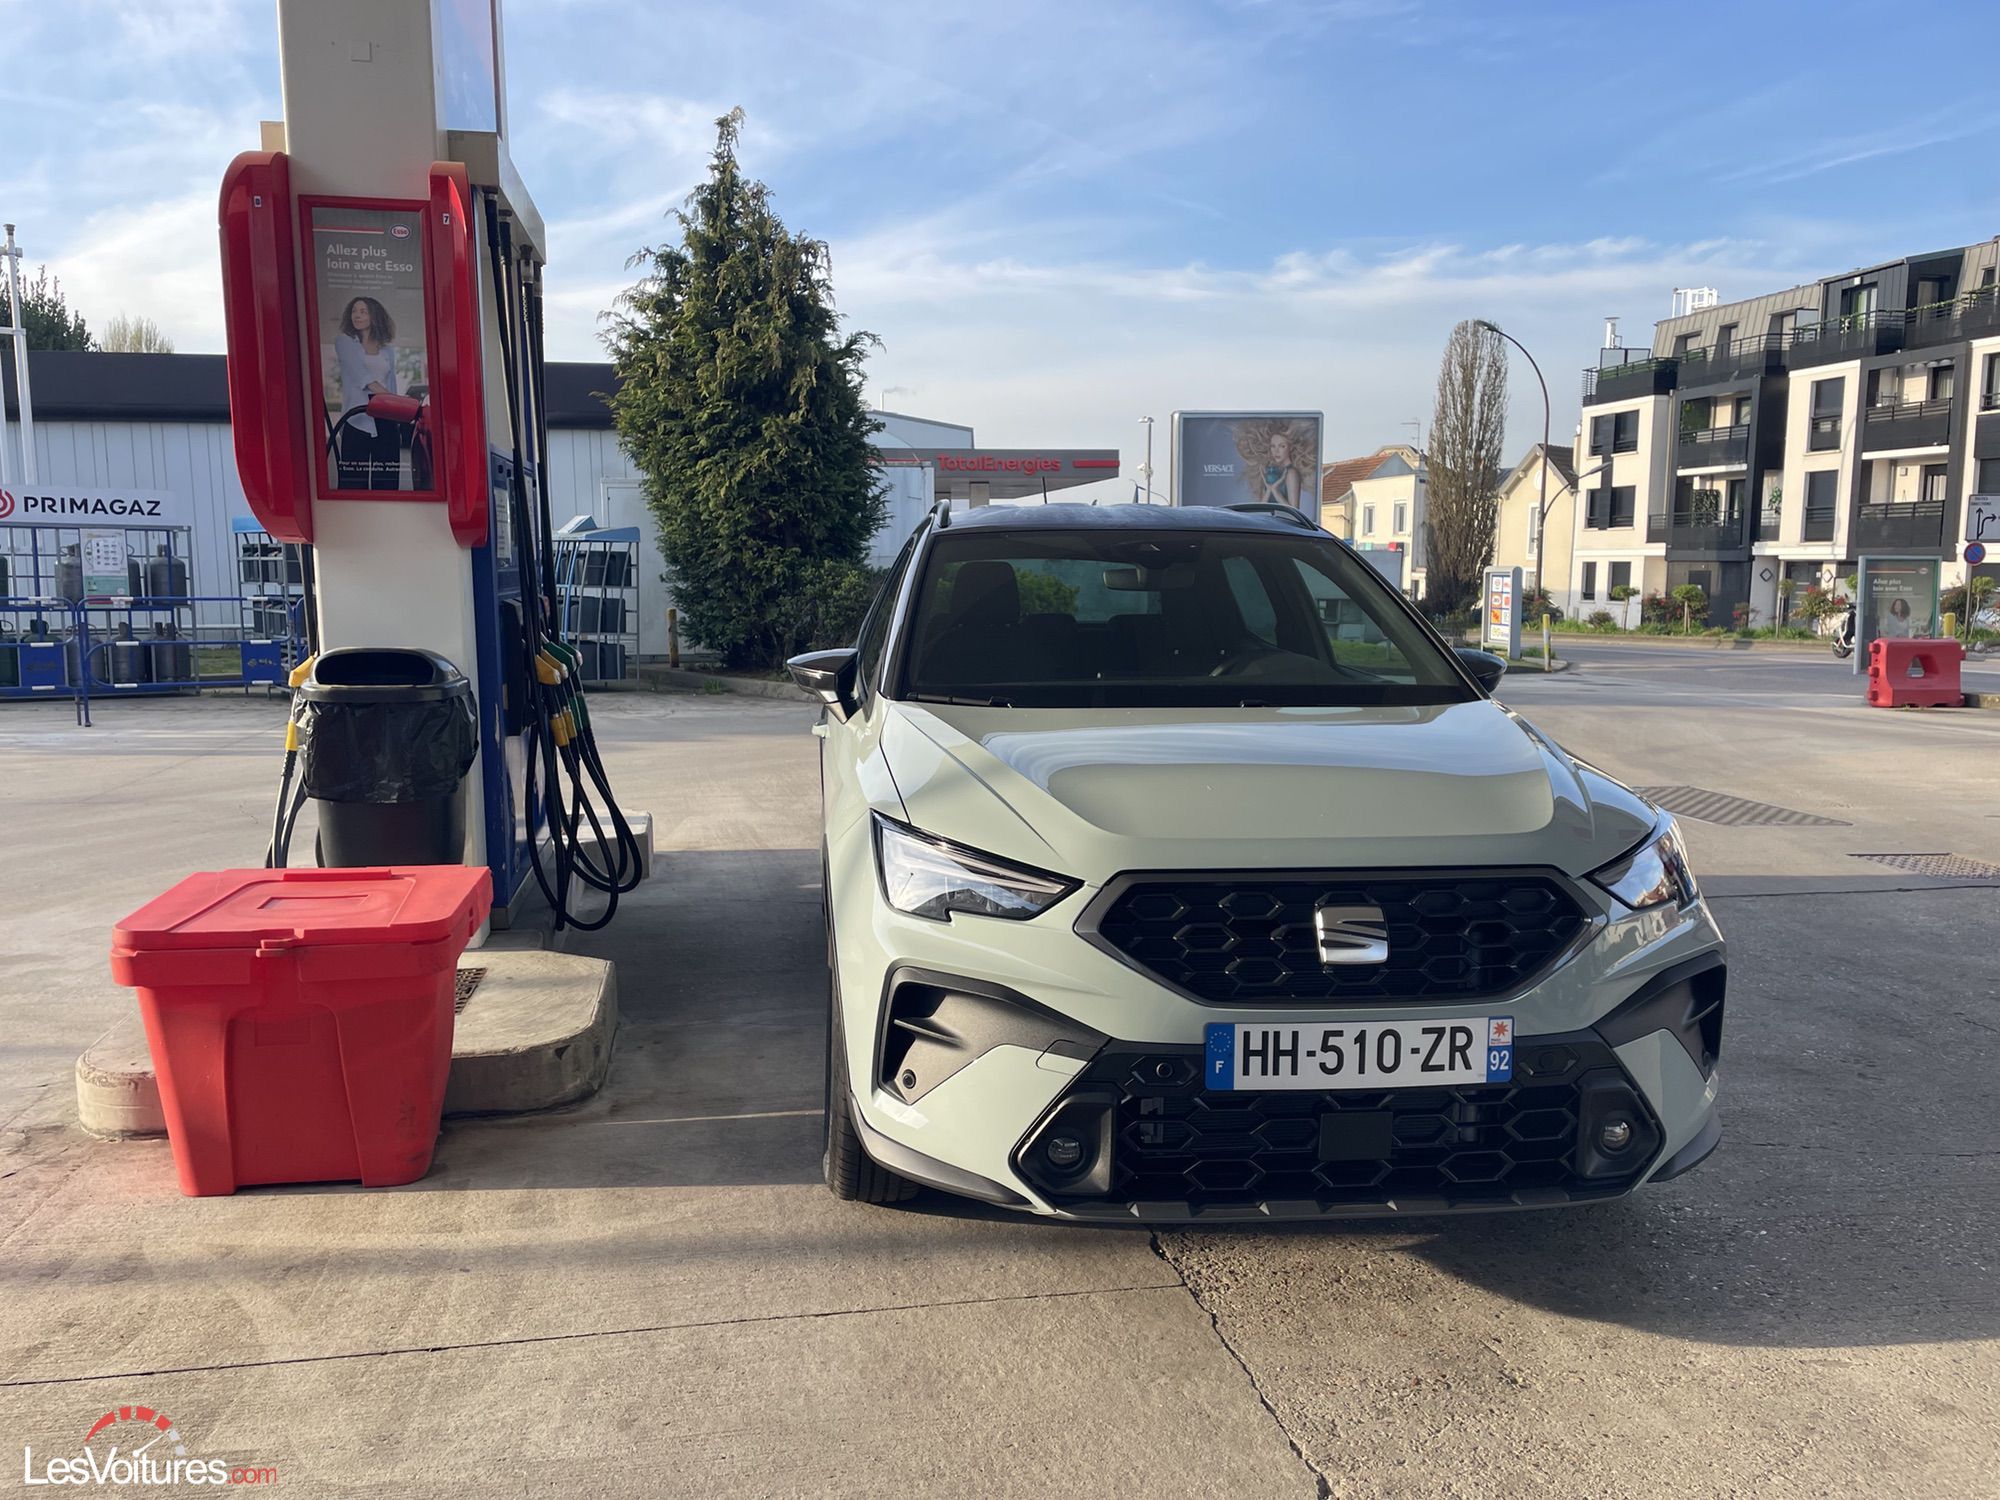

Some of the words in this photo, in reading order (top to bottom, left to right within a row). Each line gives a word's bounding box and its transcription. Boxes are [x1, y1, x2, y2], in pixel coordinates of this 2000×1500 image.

[444, 215, 449, 223] 7
[326, 243, 358, 256] Allez
[361, 245, 387, 259] plus
[327, 258, 350, 270] loin
[354, 261, 382, 271] avec
[385, 260, 413, 272] Esso
[937, 454, 1062, 476] TotalEnergies
[1203, 464, 1234, 473] VERSACE
[23, 496, 161, 516] PRIMAGAZ
[1215, 1060, 1225, 1074] F
[1242, 1025, 1473, 1077] HH-510-ZR
[1490, 1050, 1509, 1071] 92
